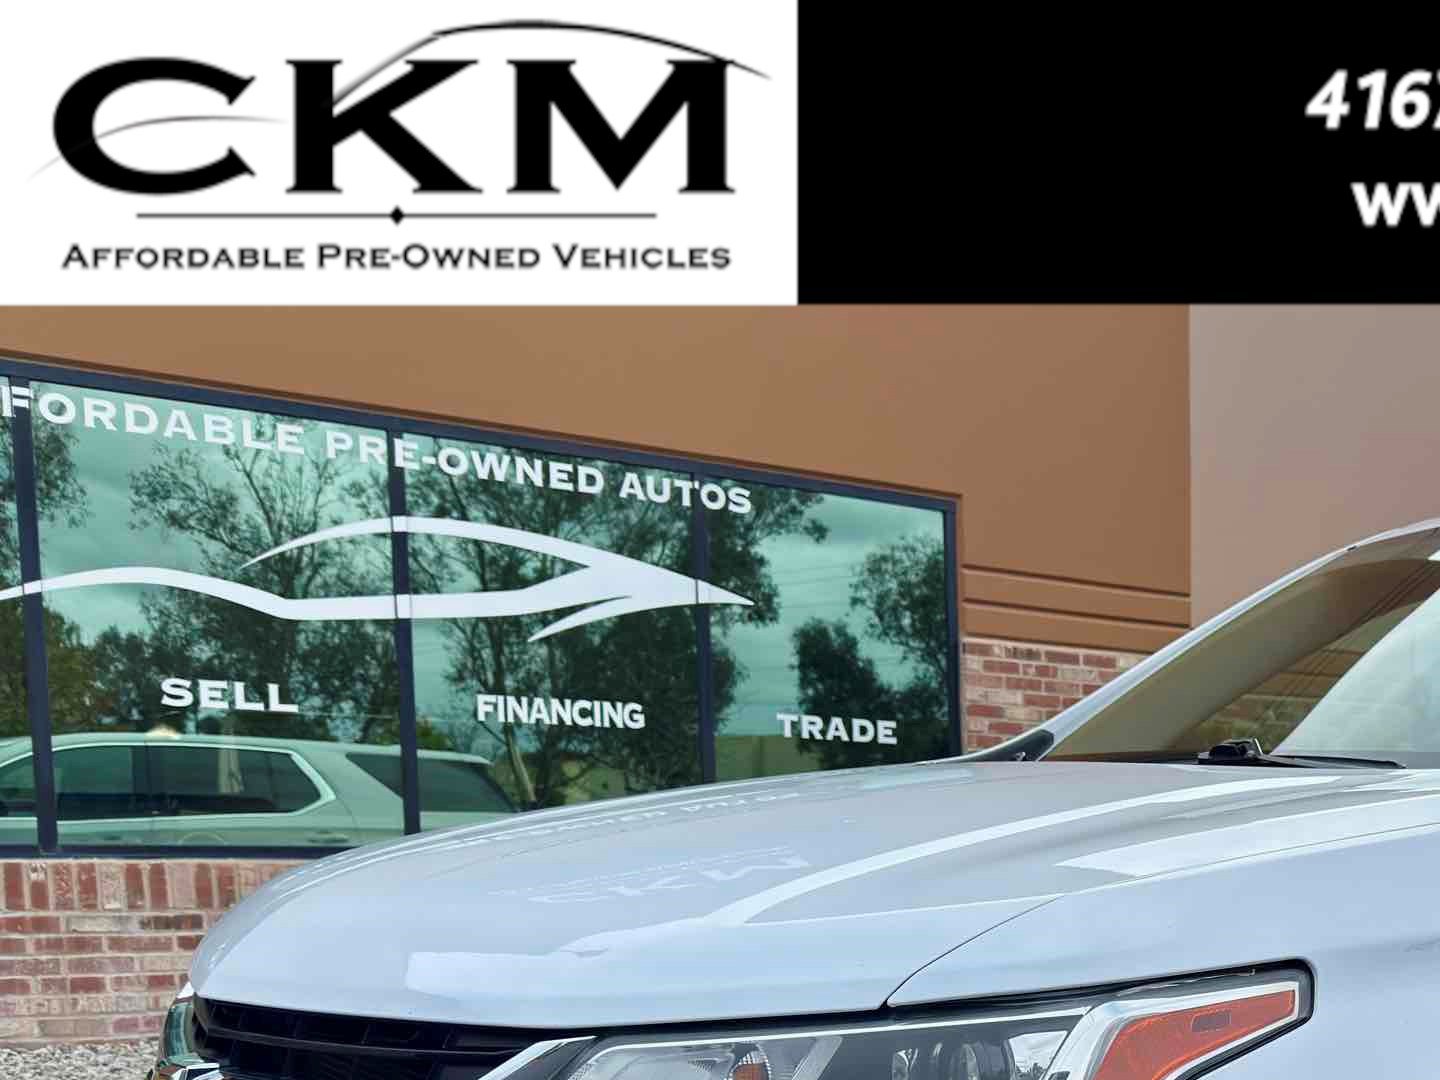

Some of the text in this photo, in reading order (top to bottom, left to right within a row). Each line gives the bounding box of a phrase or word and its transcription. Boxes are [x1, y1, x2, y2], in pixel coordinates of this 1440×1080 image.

[325, 430, 605, 496] PRE-OWNED
[619, 471, 752, 514] AUTOS
[160, 677, 300, 714] SELL
[476, 693, 647, 730] FINANCING
[776, 712, 898, 745] TRADE
